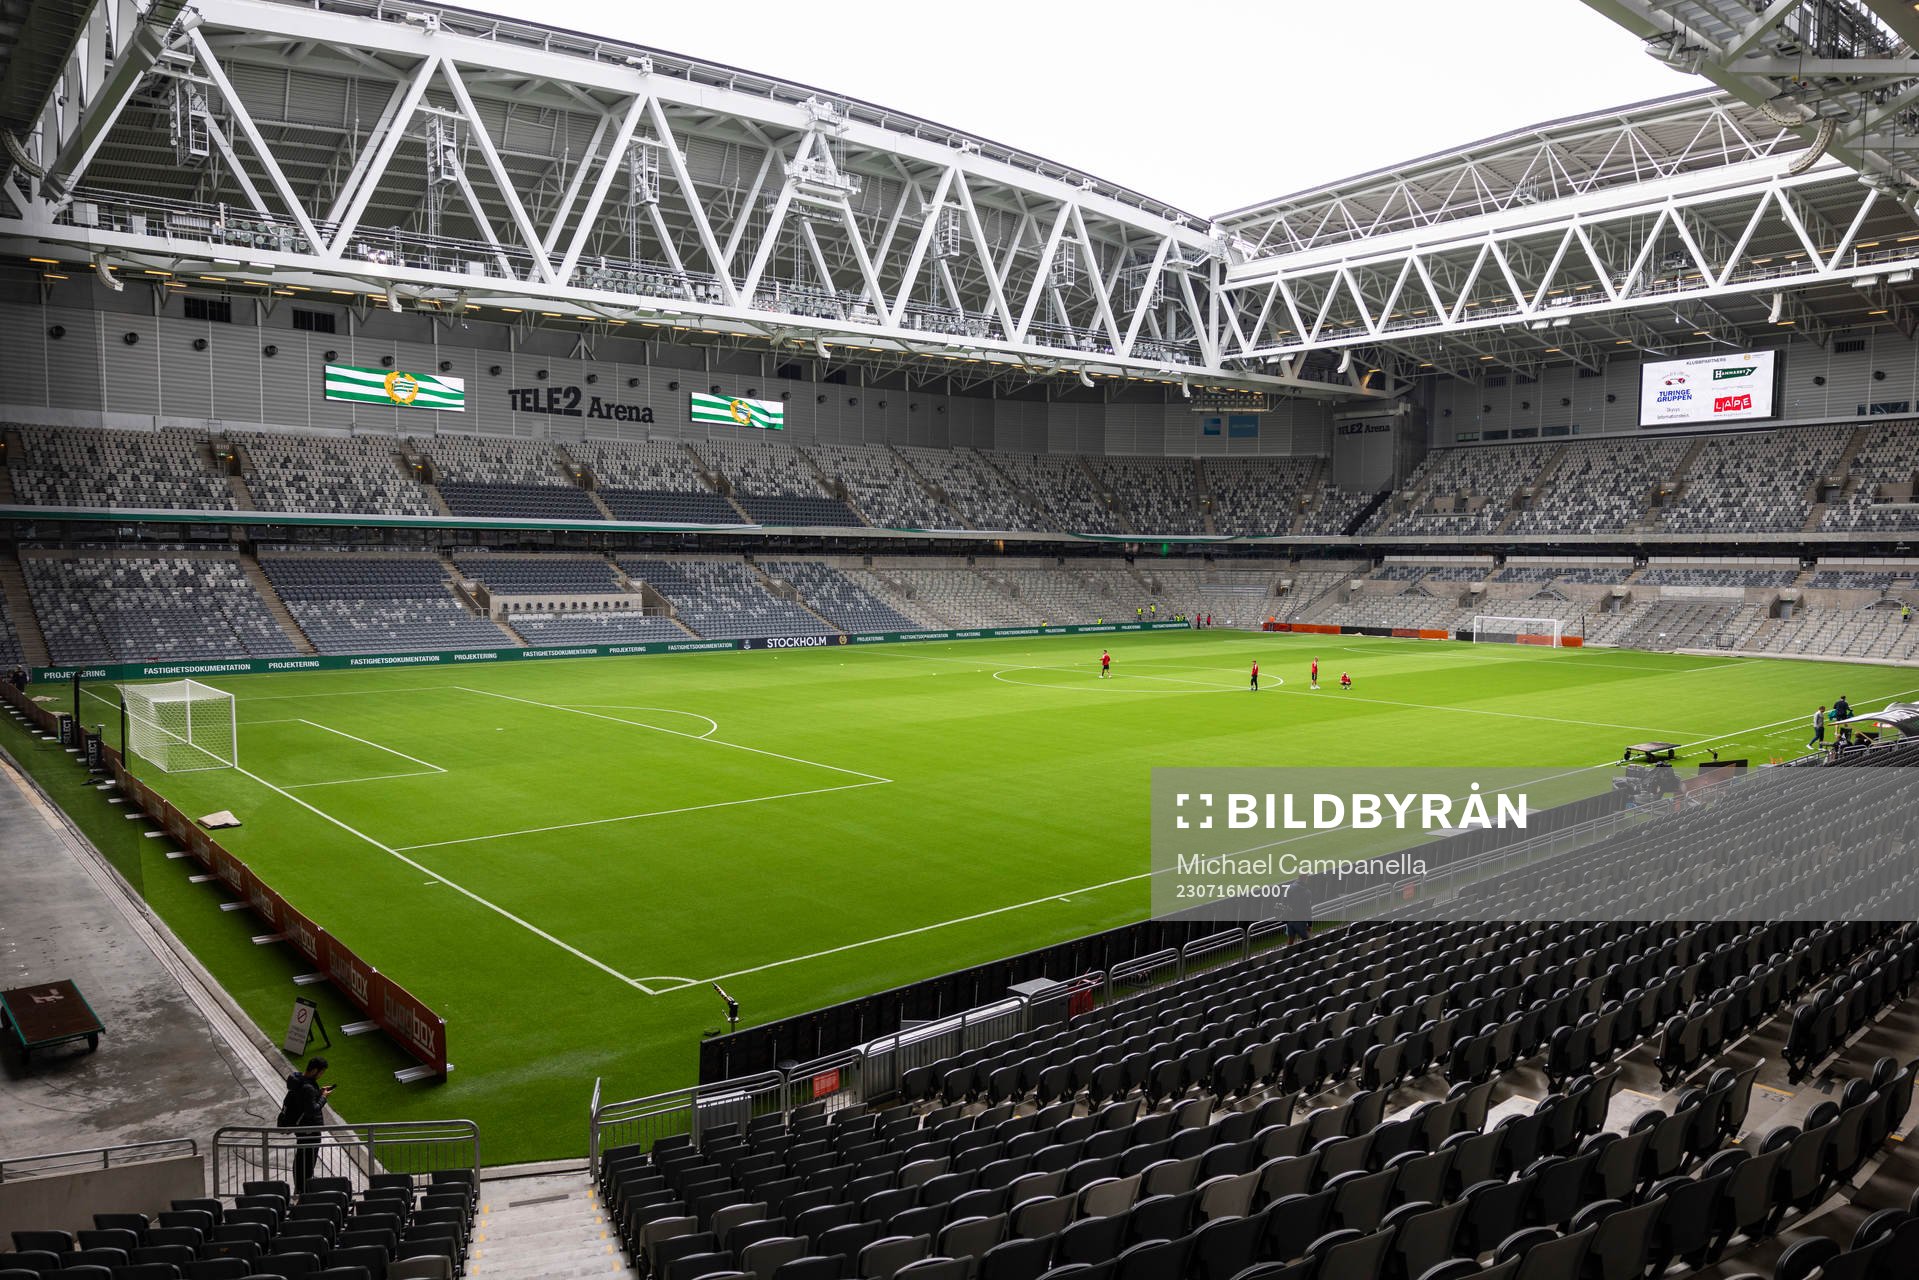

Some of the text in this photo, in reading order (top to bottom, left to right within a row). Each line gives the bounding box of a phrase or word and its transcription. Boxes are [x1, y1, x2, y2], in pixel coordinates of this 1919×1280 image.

[1659, 389, 1691, 397] TURINGE
[1657, 395, 1692, 403] GRUPPEN
[1715, 397, 1750, 410] LAPE
[508, 386, 654, 423] TELE2 Arena
[1365, 423, 1390, 434] Arena
[767, 636, 827, 648] STOCKHOLM
[522, 649, 597, 657] FASTIGHETSDOKUMENTATION
[268, 660, 320, 669] PROJEKTERING
[350, 655, 440, 665] FASTIGHETSDOKUMENTATION
[144, 663, 251, 675] FASTIGHETSDOKUMENTATION
